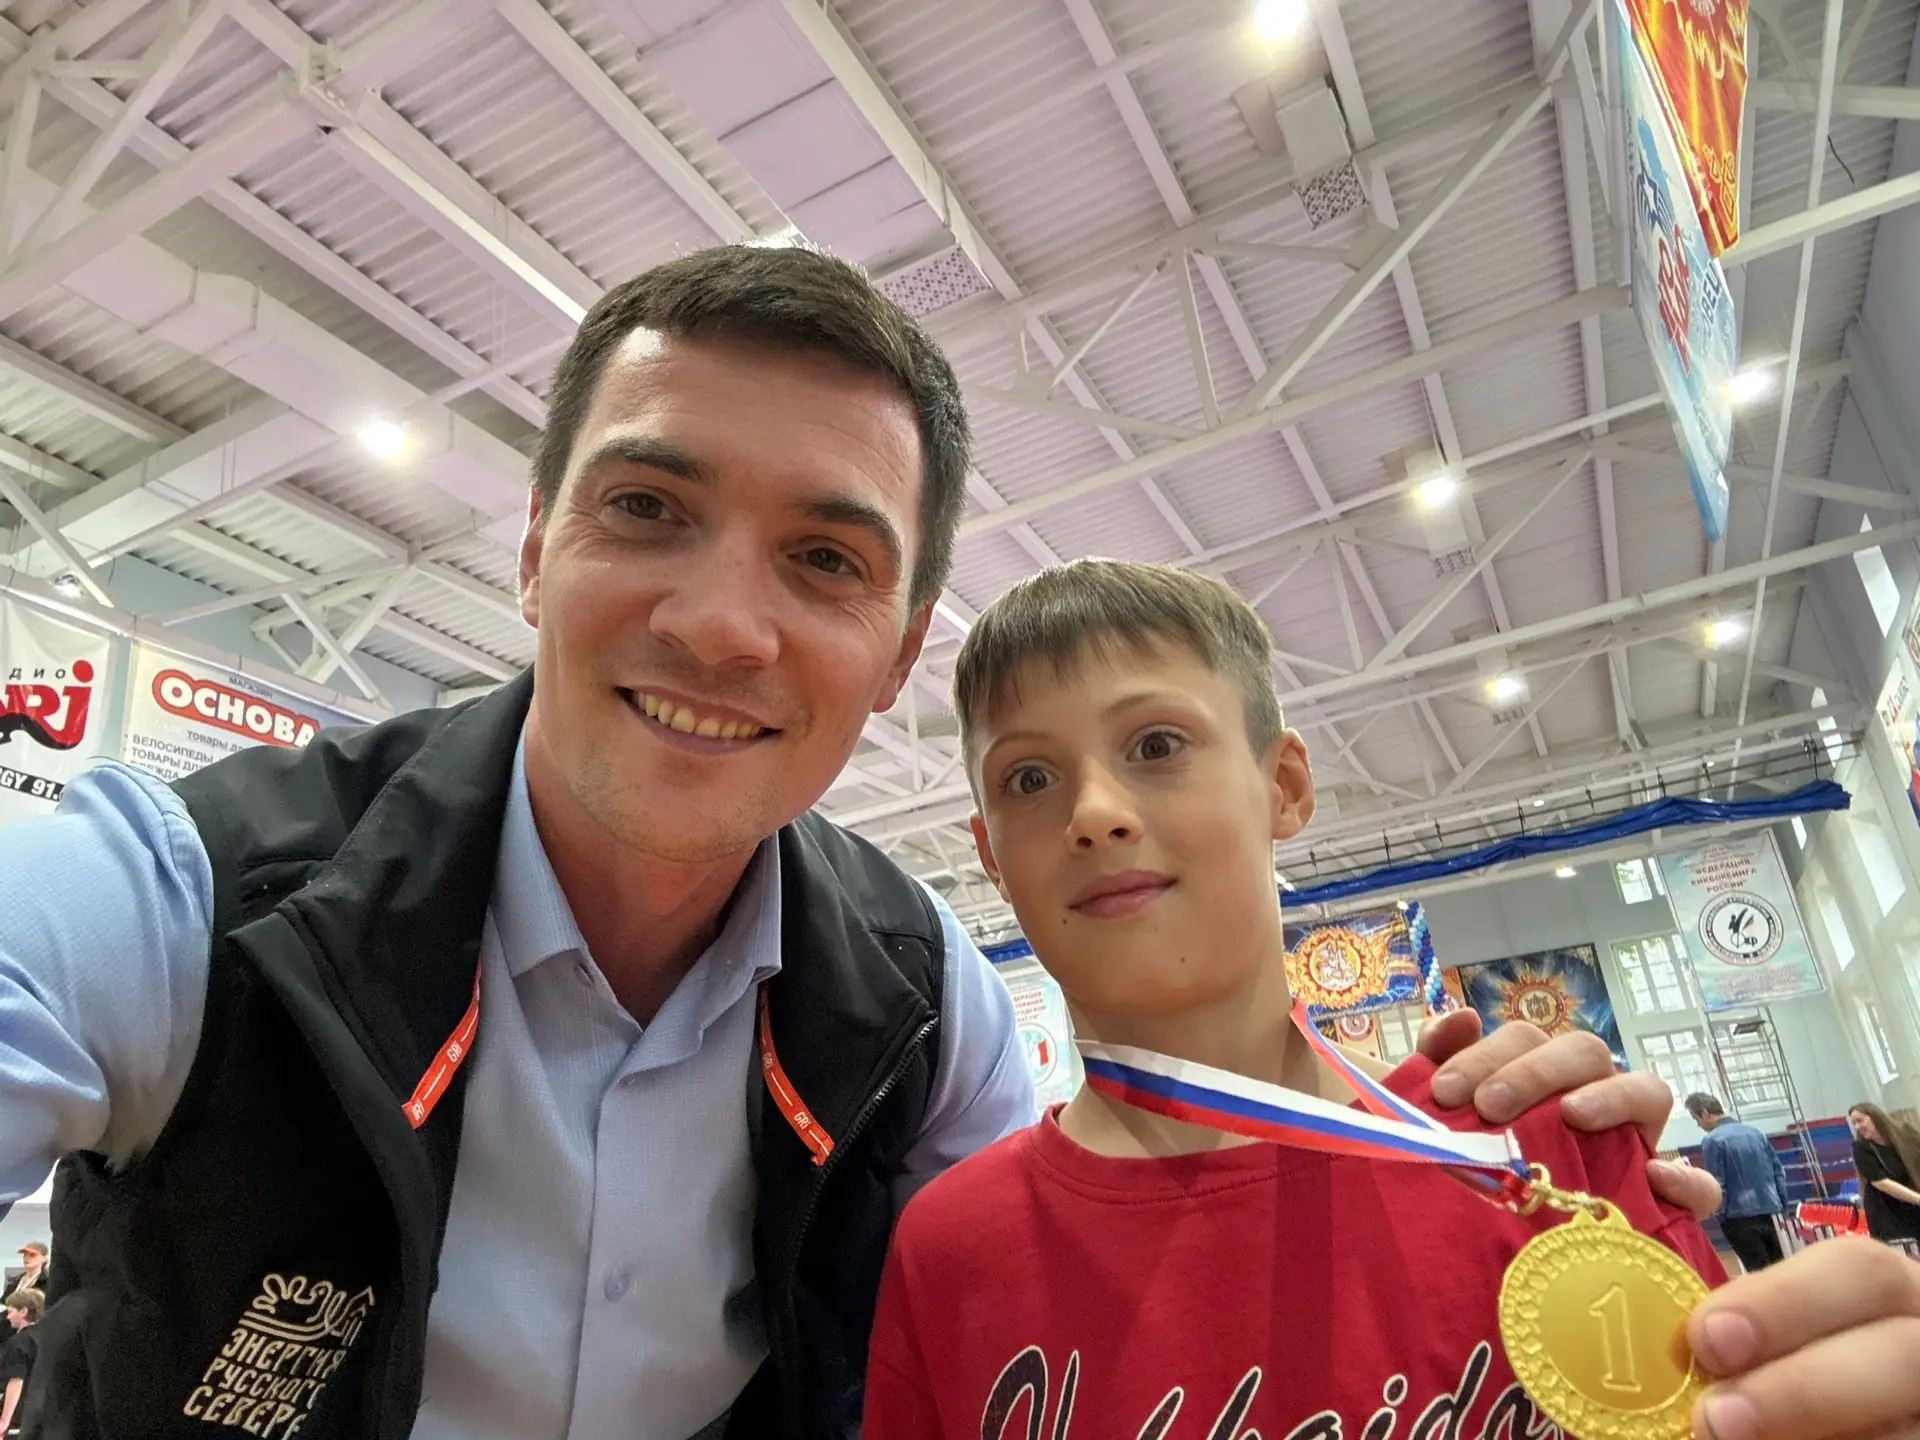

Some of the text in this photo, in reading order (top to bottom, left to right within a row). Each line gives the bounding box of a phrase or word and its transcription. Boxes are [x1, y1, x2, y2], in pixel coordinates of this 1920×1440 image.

[8, 667, 67, 680] ДИО
[228, 675, 274, 700] МАГАЗИН
[160, 676, 317, 749] ОСНОВА
[132, 734, 214, 764] ВЕЛОСИПЕДЫ
[187, 729, 244, 754] товары дл
[131, 746, 182, 769] ТОВАРЫ
[1587, 1284, 1642, 1392] 1
[221, 1327, 348, 1379] ЭНЕРГИЯ
